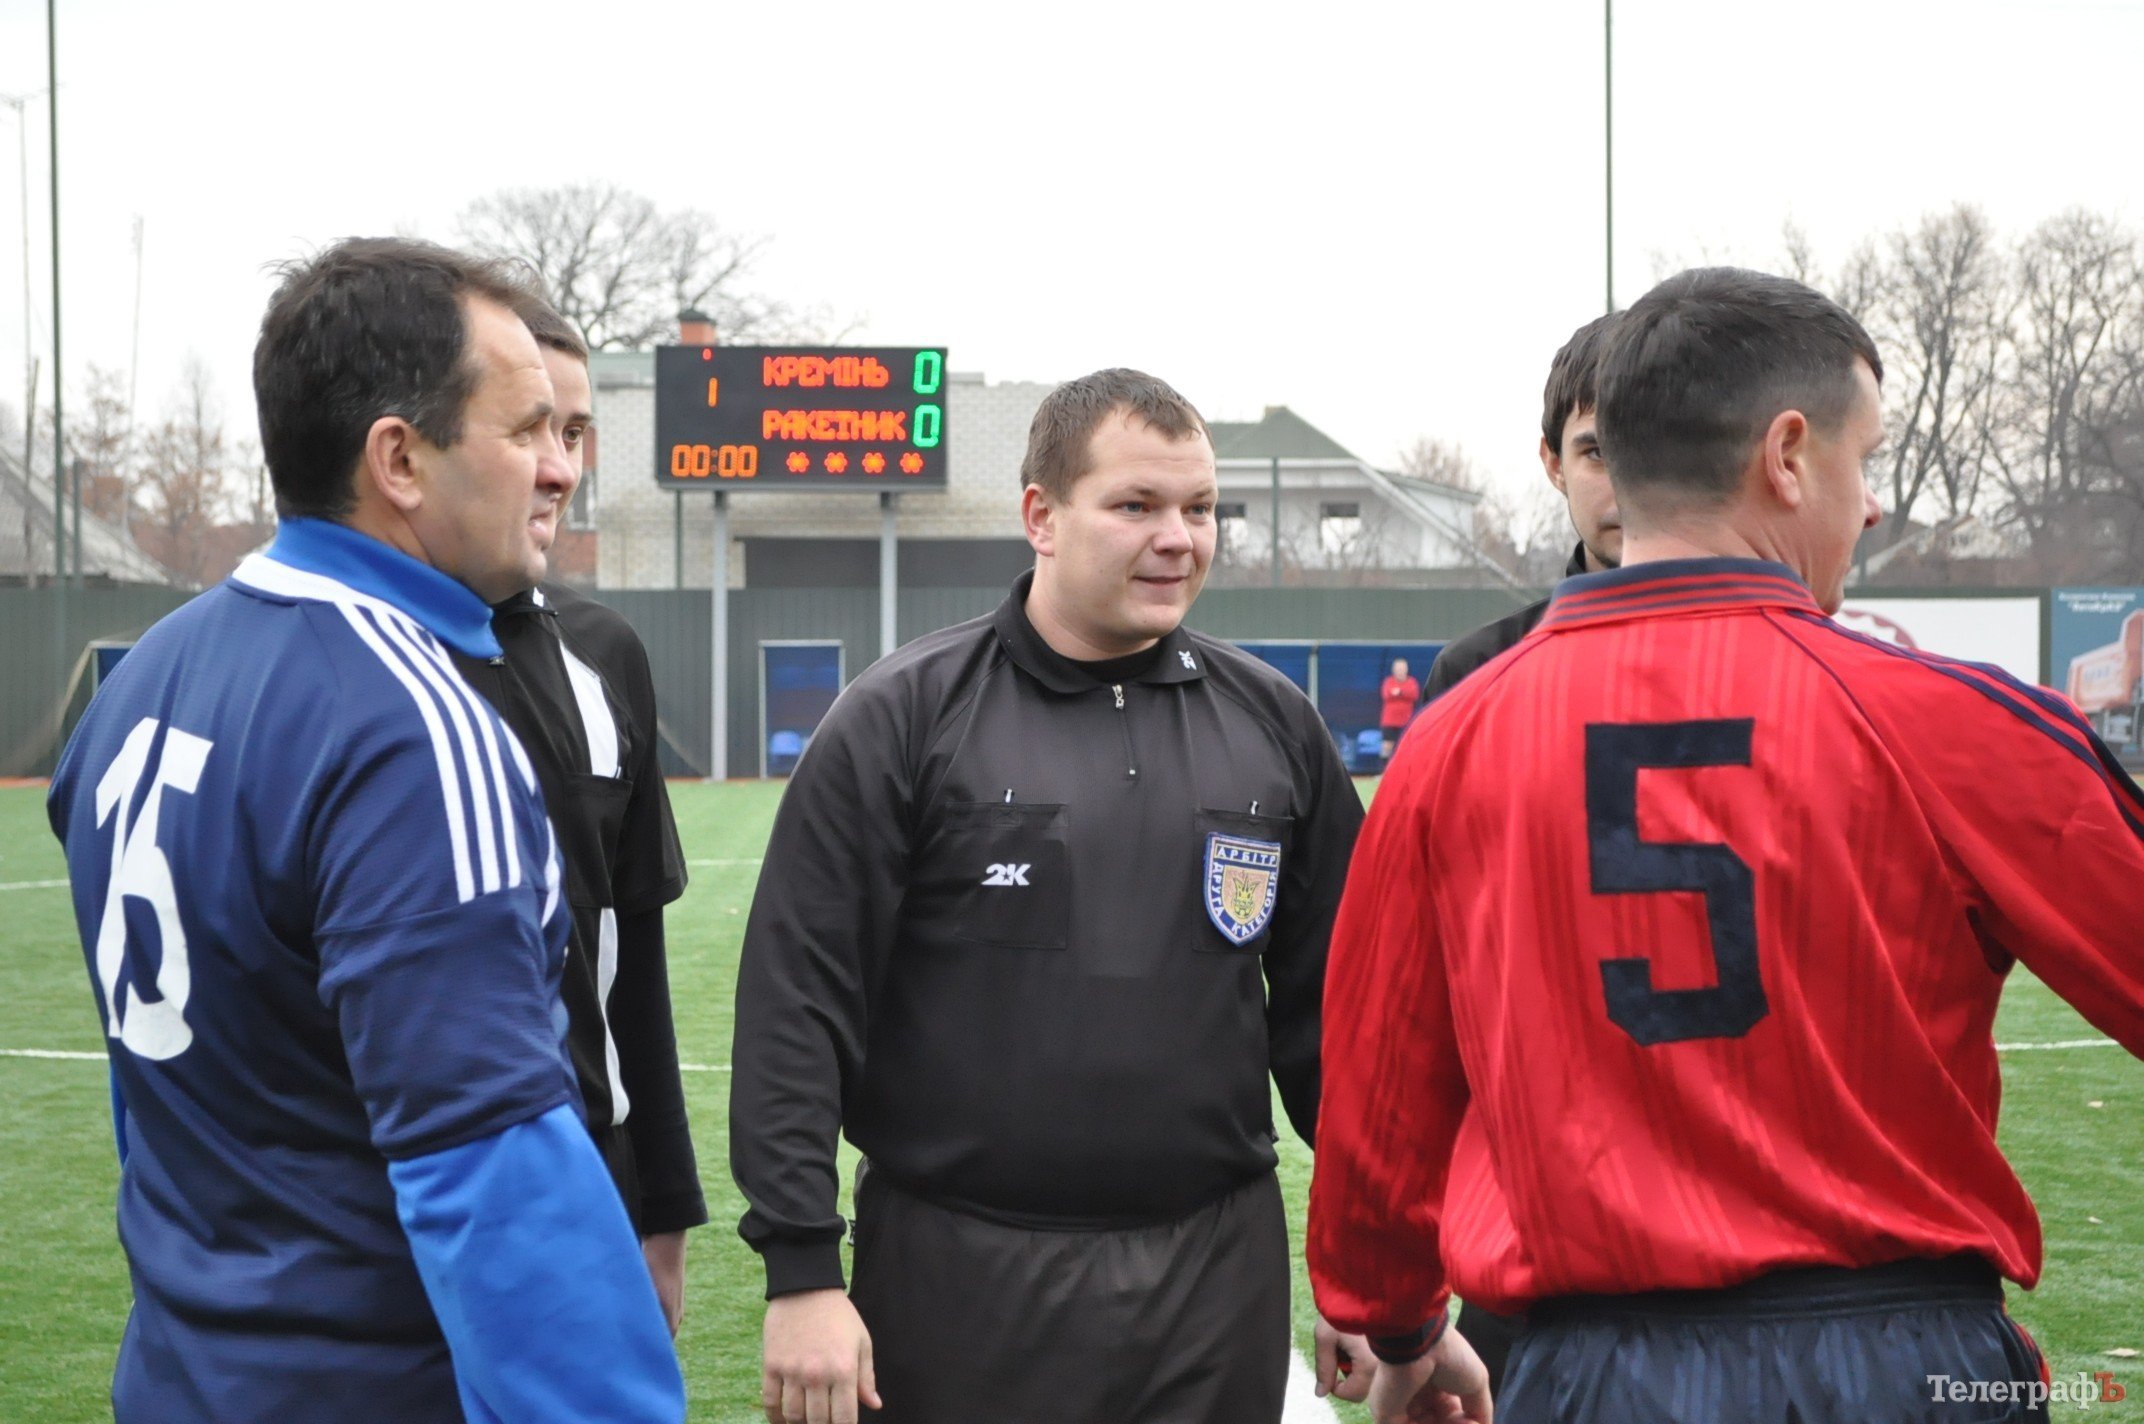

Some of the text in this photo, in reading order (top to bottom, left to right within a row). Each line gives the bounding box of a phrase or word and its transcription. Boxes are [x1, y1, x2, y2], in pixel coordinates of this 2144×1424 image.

[763, 351, 941, 394] КРЕМІНЬ 0
[762, 404, 941, 447] РАКЕТНИК 0
[671, 445, 758, 478] 00:00
[981, 863, 1031, 886] 2K
[1217, 846, 1277, 867] АРБІТР
[1211, 861, 1225, 917] ДРУГА
[1231, 871, 1277, 936] КАТЕГОРІЯ
[1585, 718, 1770, 1047] 5
